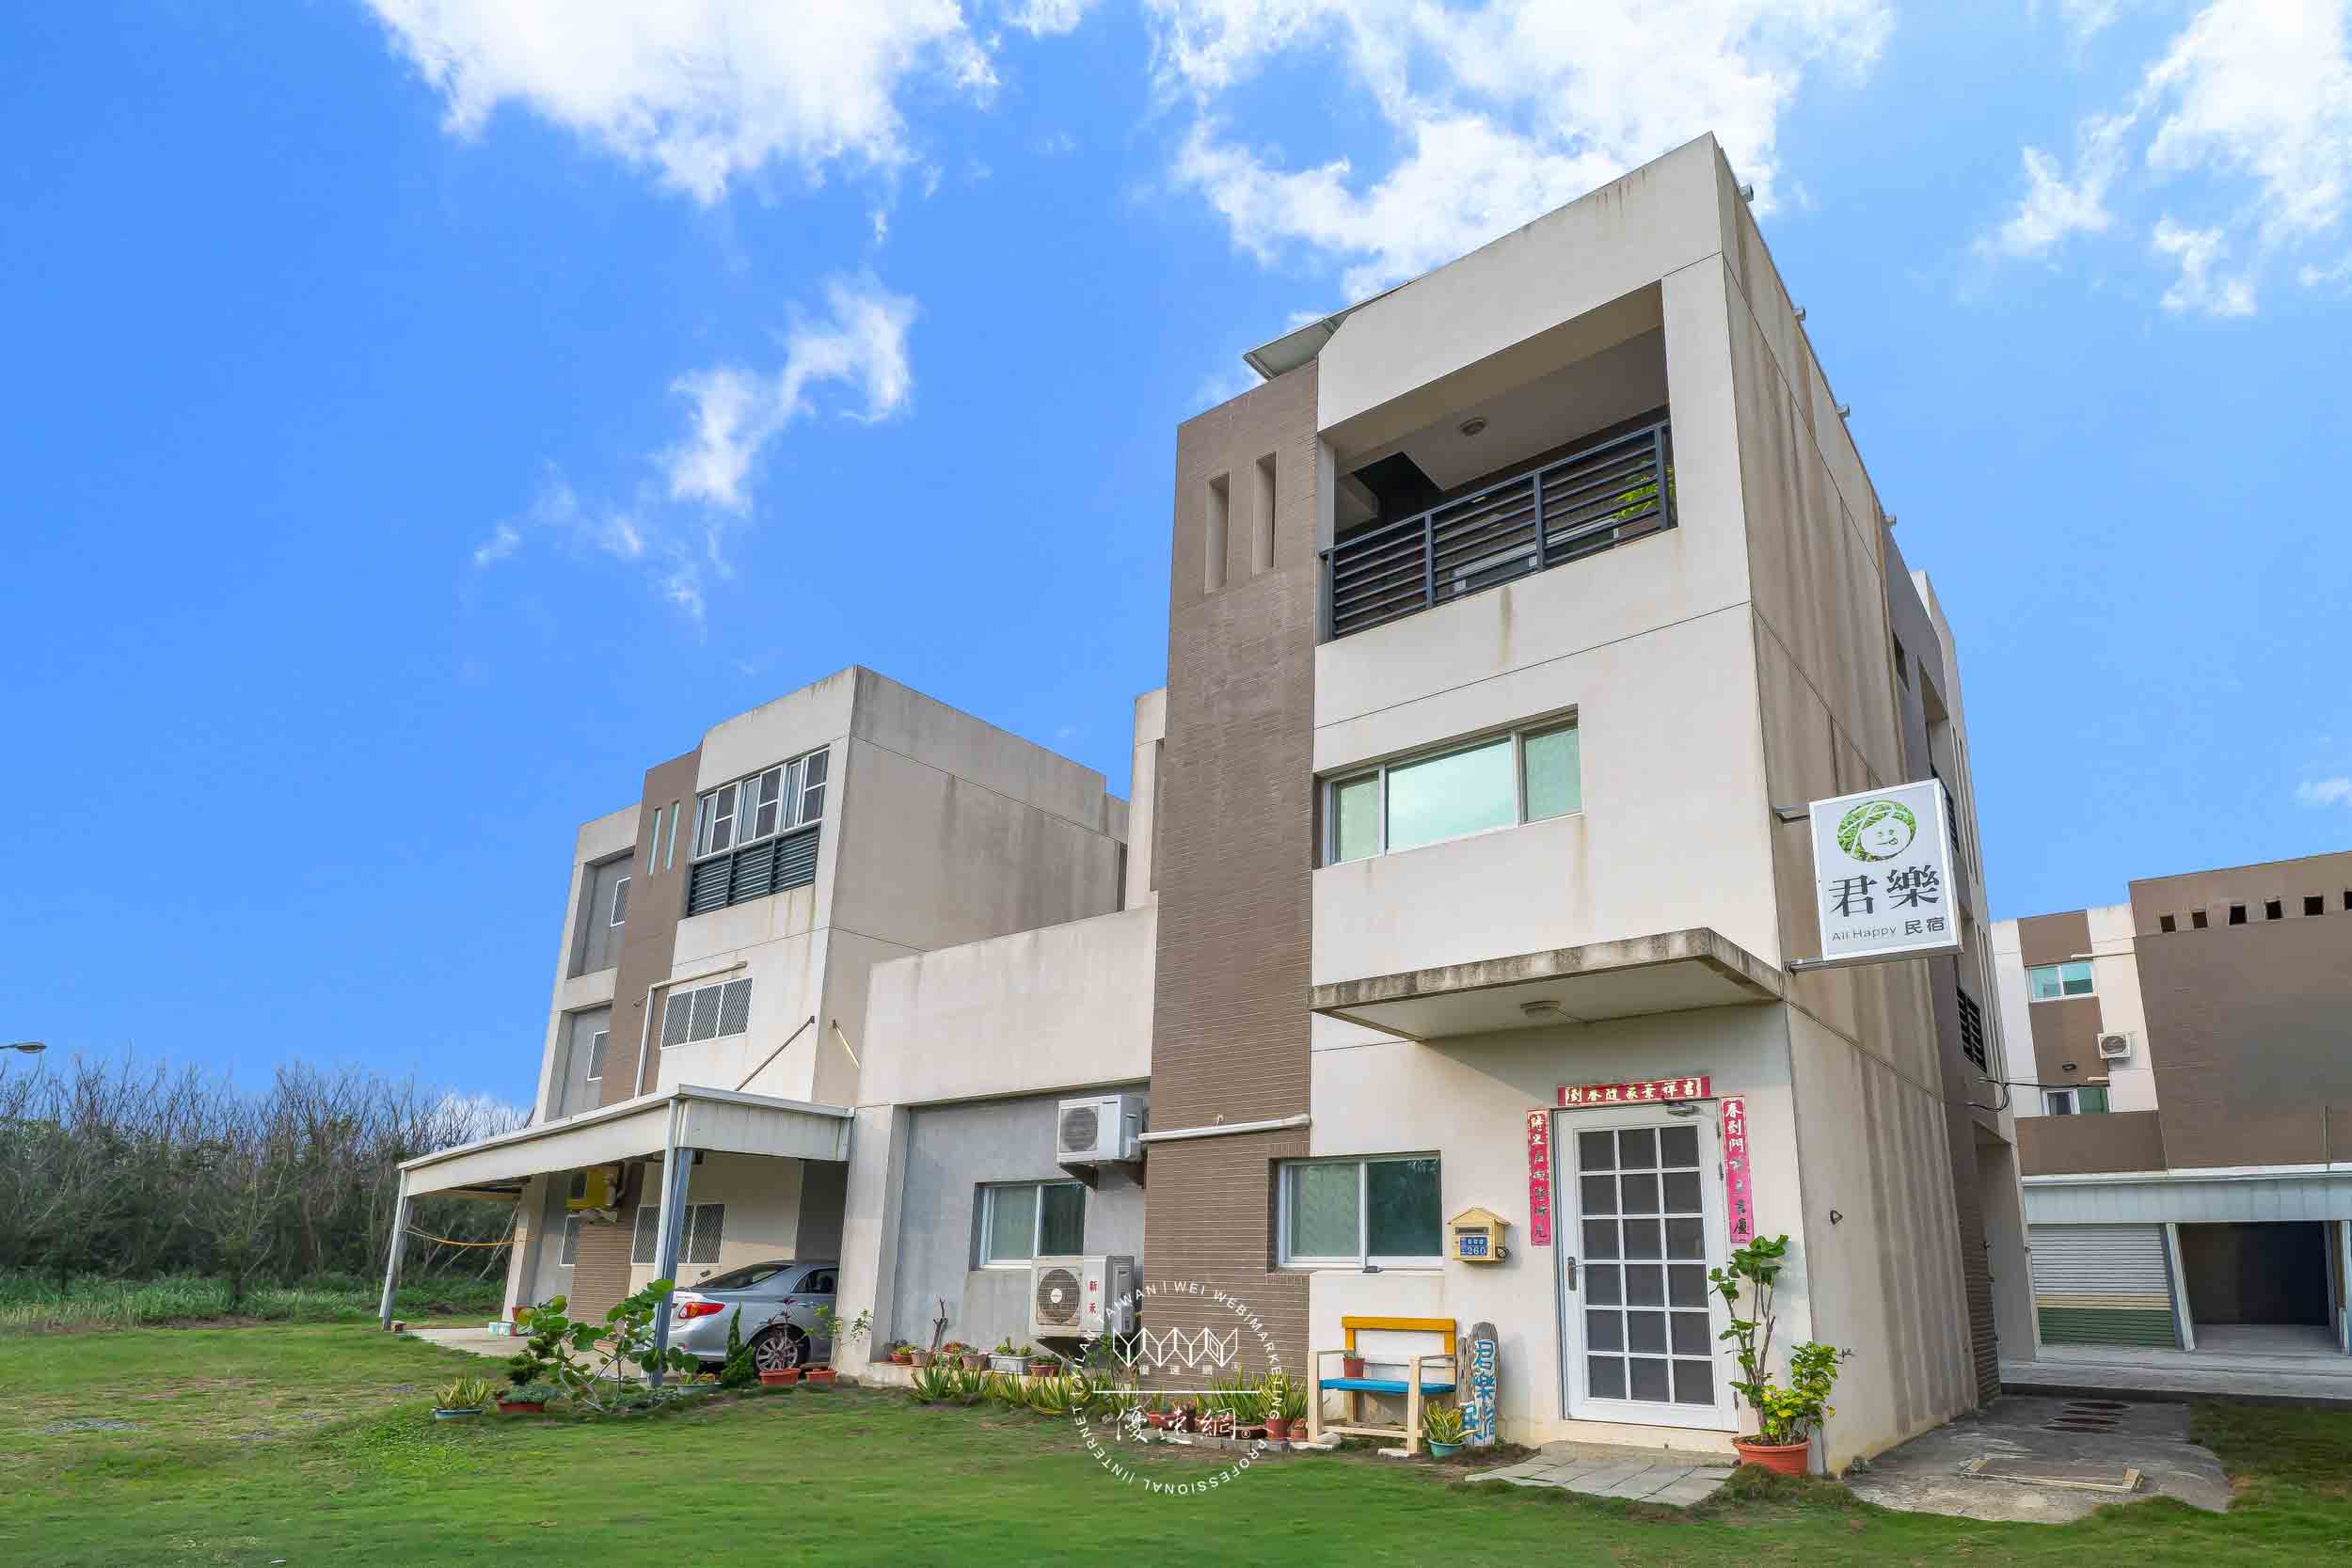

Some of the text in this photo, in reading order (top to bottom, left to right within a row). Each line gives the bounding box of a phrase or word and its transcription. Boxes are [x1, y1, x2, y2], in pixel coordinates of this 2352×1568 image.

[1828, 864, 1940, 917] 君樂
[1852, 926, 1898, 940] Happy
[1903, 916, 1945, 936] 民宿
[1467, 1246, 1486, 1256] 260
